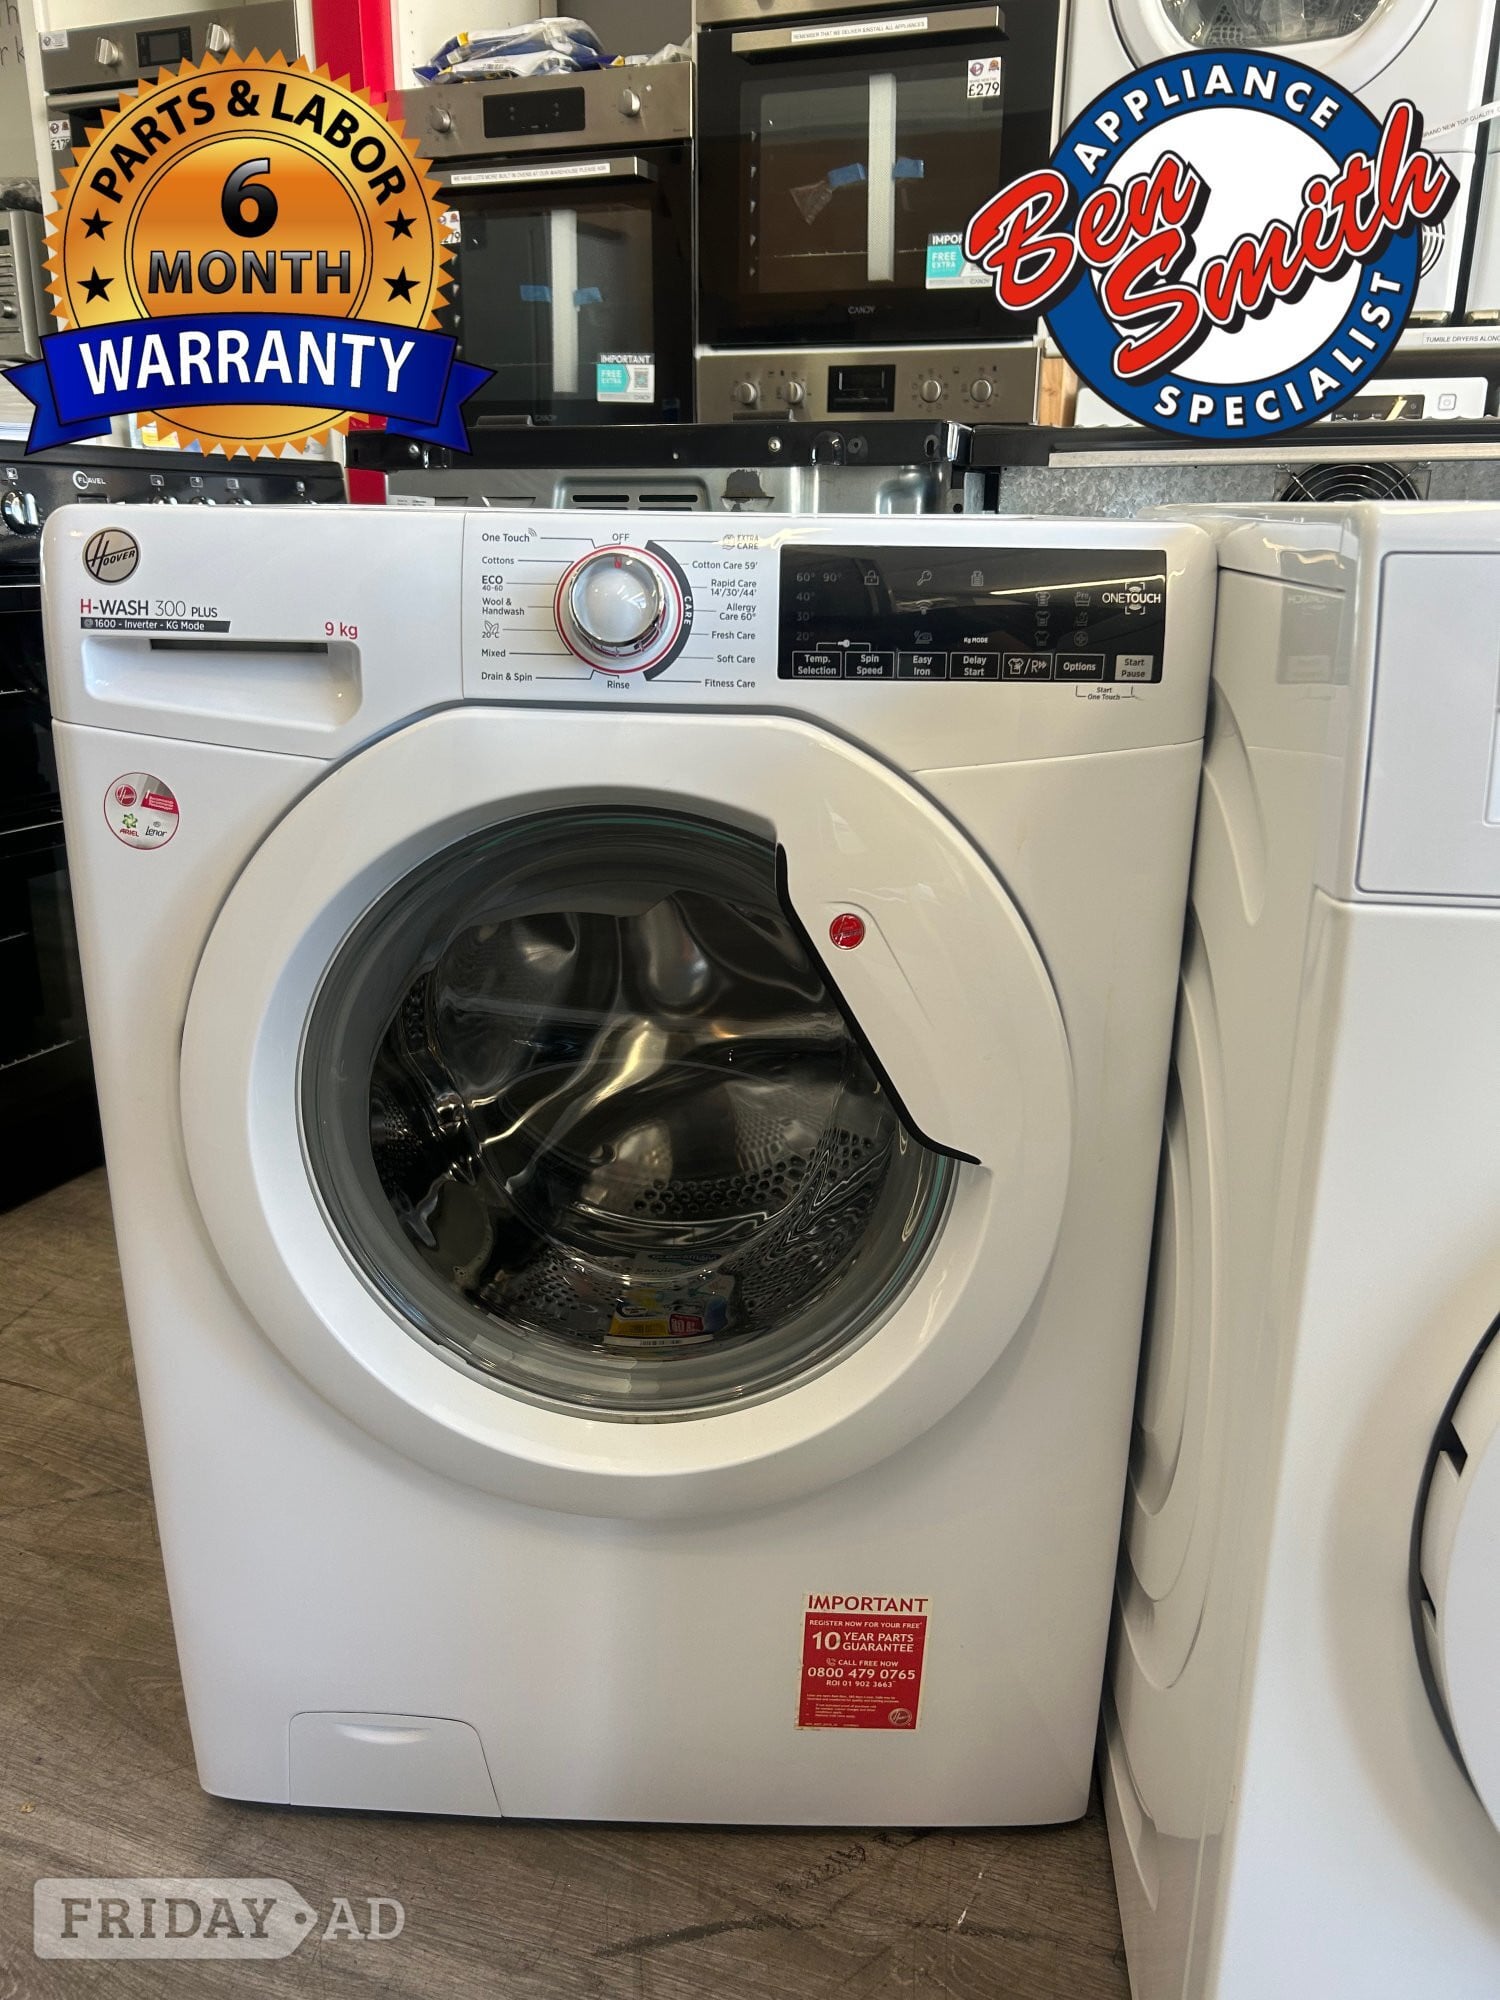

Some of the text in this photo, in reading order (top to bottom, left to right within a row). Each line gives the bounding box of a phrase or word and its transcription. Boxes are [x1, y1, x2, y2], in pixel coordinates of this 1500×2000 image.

[969, 81, 999, 96] £279
[1469, 109, 1495, 122] QUALITY
[932, 251, 956, 261] FREE
[931, 261, 956, 269] EXTRA
[600, 354, 651, 363] IMPORTANT
[601, 369, 622, 378] FREE
[78, 476, 107, 485] FLAVEL
[481, 533, 530, 542] One Touch
[612, 533, 630, 542] OFF
[737, 534, 759, 542] EXTRA
[481, 556, 515, 565] Cottons
[692, 560, 721, 569] Cotton
[723, 561, 743, 570] Care
[482, 575, 503, 585] ECO
[711, 579, 757, 588] Rapid Care
[482, 584, 504, 592] 40-60
[482, 597, 512, 606] Wool &
[1101, 592, 1161, 604] ONETOUCH
[80, 598, 218, 617] H-WASH 300 PLUS
[482, 606, 525, 616] Handwash
[683, 595, 692, 626] CARE
[726, 603, 757, 613] Allergy
[719, 612, 738, 621] Care
[95, 619, 116, 628] 1600
[124, 620, 158, 629] Inverter
[166, 621, 179, 630] KG
[181, 621, 205, 631] Mode
[324, 621, 358, 640] 9 kg
[711, 630, 756, 640] Fresh Care
[481, 649, 506, 658] Mixed
[716, 654, 756, 664] Soft Care
[804, 655, 831, 664] Temp.
[860, 654, 880, 664] Spin
[912, 655, 933, 665] Easy
[963, 655, 987, 666] Delay
[1124, 658, 1145, 667] Start
[797, 666, 837, 675] Selection
[856, 666, 883, 676] Speed
[913, 667, 931, 676] Iron
[963, 667, 985, 676] Start
[1063, 661, 1096, 672] Options
[481, 672, 533, 683] Drain & Spin
[1121, 670, 1146, 678] Pause
[607, 679, 630, 690] Rinse
[704, 678, 756, 689] Fitness Care
[1096, 686, 1113, 694] Start
[145, 825, 168, 837] Lenor
[808, 1594, 929, 1612] IMPORTANT
[809, 1619, 843, 1627] REGISTER
[812, 1631, 914, 1651] 10 YEAR PARTS
[842, 1642, 914, 1653] GUARANTEE
[808, 1667, 916, 1680] 0800 479 0765
